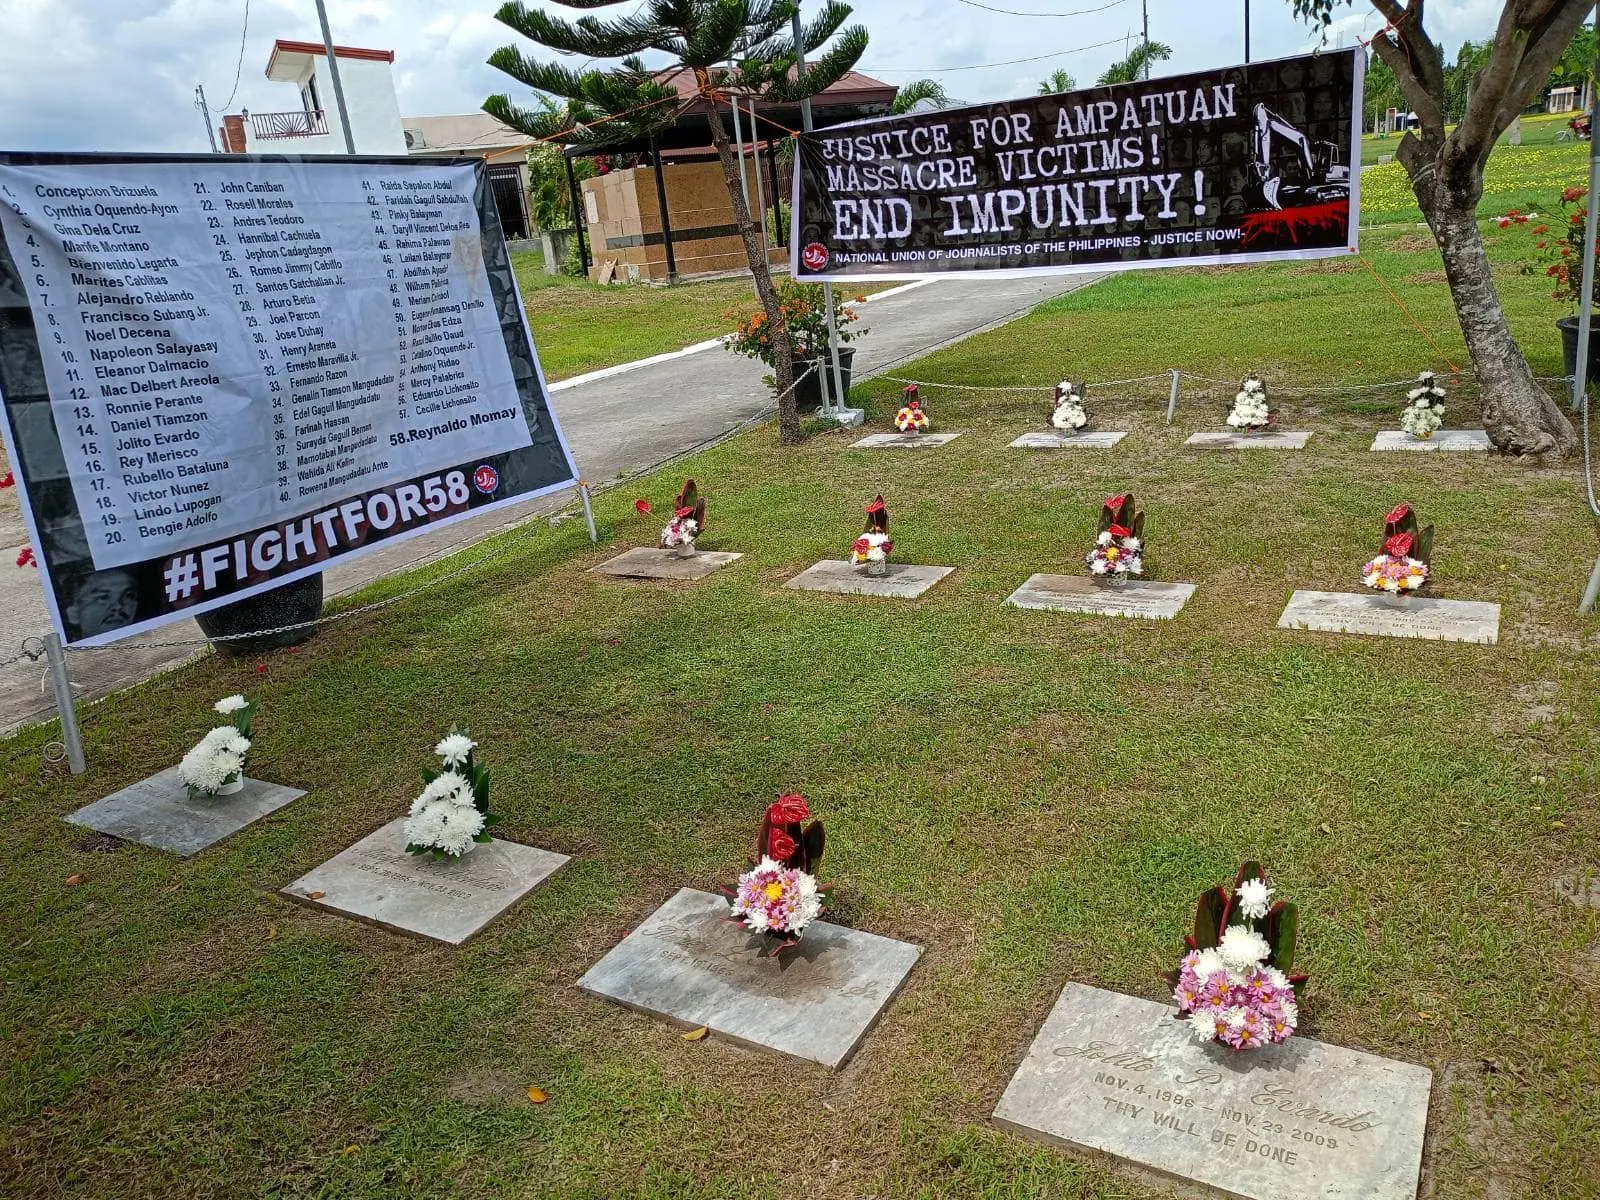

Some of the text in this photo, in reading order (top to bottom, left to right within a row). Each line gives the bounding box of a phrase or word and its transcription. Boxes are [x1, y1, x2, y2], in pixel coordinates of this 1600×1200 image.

[822, 83, 1237, 161] JUSTICE FOR AMPATUAN
[826, 134, 1160, 193] MASSACRE VICTIMS!
[36, 185, 158, 200] Concepcion Brizuela
[194, 181, 284, 194] 21. John Caniban
[43, 203, 179, 220] Cynthia Oquendo-Ayon
[201, 199, 293, 211] 22. Rosell Morales
[389, 209, 408, 221] Pinky
[207, 214, 304, 228] 23. Andres Teodoro
[832, 198, 914, 240] END
[54, 223, 141, 236] Gina Dela Cruz
[213, 230, 320, 245] 24. Hannibal Cachuela
[26, 235, 40, 247] 4.
[100, 241, 150, 252] Montano
[836, 253, 889, 263] NATIONAL
[892, 251, 926, 262] UNION
[928, 250, 943, 260] OF
[945, 245, 1021, 259] JOURNALISTS
[1025, 244, 1040, 254] OF
[1043, 242, 1065, 253] THE
[1069, 237, 1140, 251] PHILIPPINES
[1151, 230, 1203, 246] JUSTICE
[1206, 228, 1245, 241] NOW!-
[31, 255, 179, 272] 5. Bienvenido Legarta
[220, 250, 236, 261] 25.
[245, 249, 279, 262] Jephon
[226, 259, 342, 278] 26. Romeo Jimmy Cabillo
[36, 273, 168, 288] 6. Marites Cablitas
[233, 275, 345, 295] 27. Santos Gatchalian Jr.
[40, 290, 194, 307] 7. Alejandro Reblando
[240, 301, 254, 311] 28.
[263, 297, 291, 310] Arturo
[48, 306, 210, 326] 8. Francisco Subang Jr.
[246, 311, 320, 327] 29. Joel Parcon
[54, 328, 171, 344] 9. Noel Decena
[253, 326, 323, 343] 30. Jose Duhay
[444, 329, 464, 341] Daud
[61, 341, 218, 363] 10. Napoleon Salayasay
[259, 340, 337, 360] 31. Henry Araneta
[66, 358, 209, 382] 11. Eleanor Dalmacio
[264, 365, 279, 376] 32.
[286, 360, 317, 373] Ernesto
[351, 352, 359, 361] Jr.
[70, 374, 220, 400] 12. Mac Delbert Areola
[269, 369, 348, 392] 33. Fernando Razon
[73, 395, 203, 419] 13. Ronnie Perante
[293, 408, 310, 420] Edel
[77, 411, 208, 436] 14. Daniel Tiamzon
[324, 416, 350, 428] Hassan
[390, 408, 516, 446] 58.Reynaldo Momay
[81, 429, 200, 455] 15. Jolito Evardo
[85, 448, 198, 473] 16. Rey Merisco
[372, 461, 388, 474] Ante
[91, 460, 229, 491] 17. Rubello Bataluna
[96, 482, 210, 510] 18. Victor Nunez
[102, 495, 222, 526] 19. Lindo Lupogan
[105, 513, 218, 545] 20. Bengie Adolfo
[164, 470, 471, 603] #FIGHTFOR58
[1251, 1083, 1382, 1132] Evardo
[1156, 1089, 1195, 1108] 1986
[1291, 1129, 1338, 1149] 2009
[1103, 1096, 1298, 1165] THY WILL BE DONE
